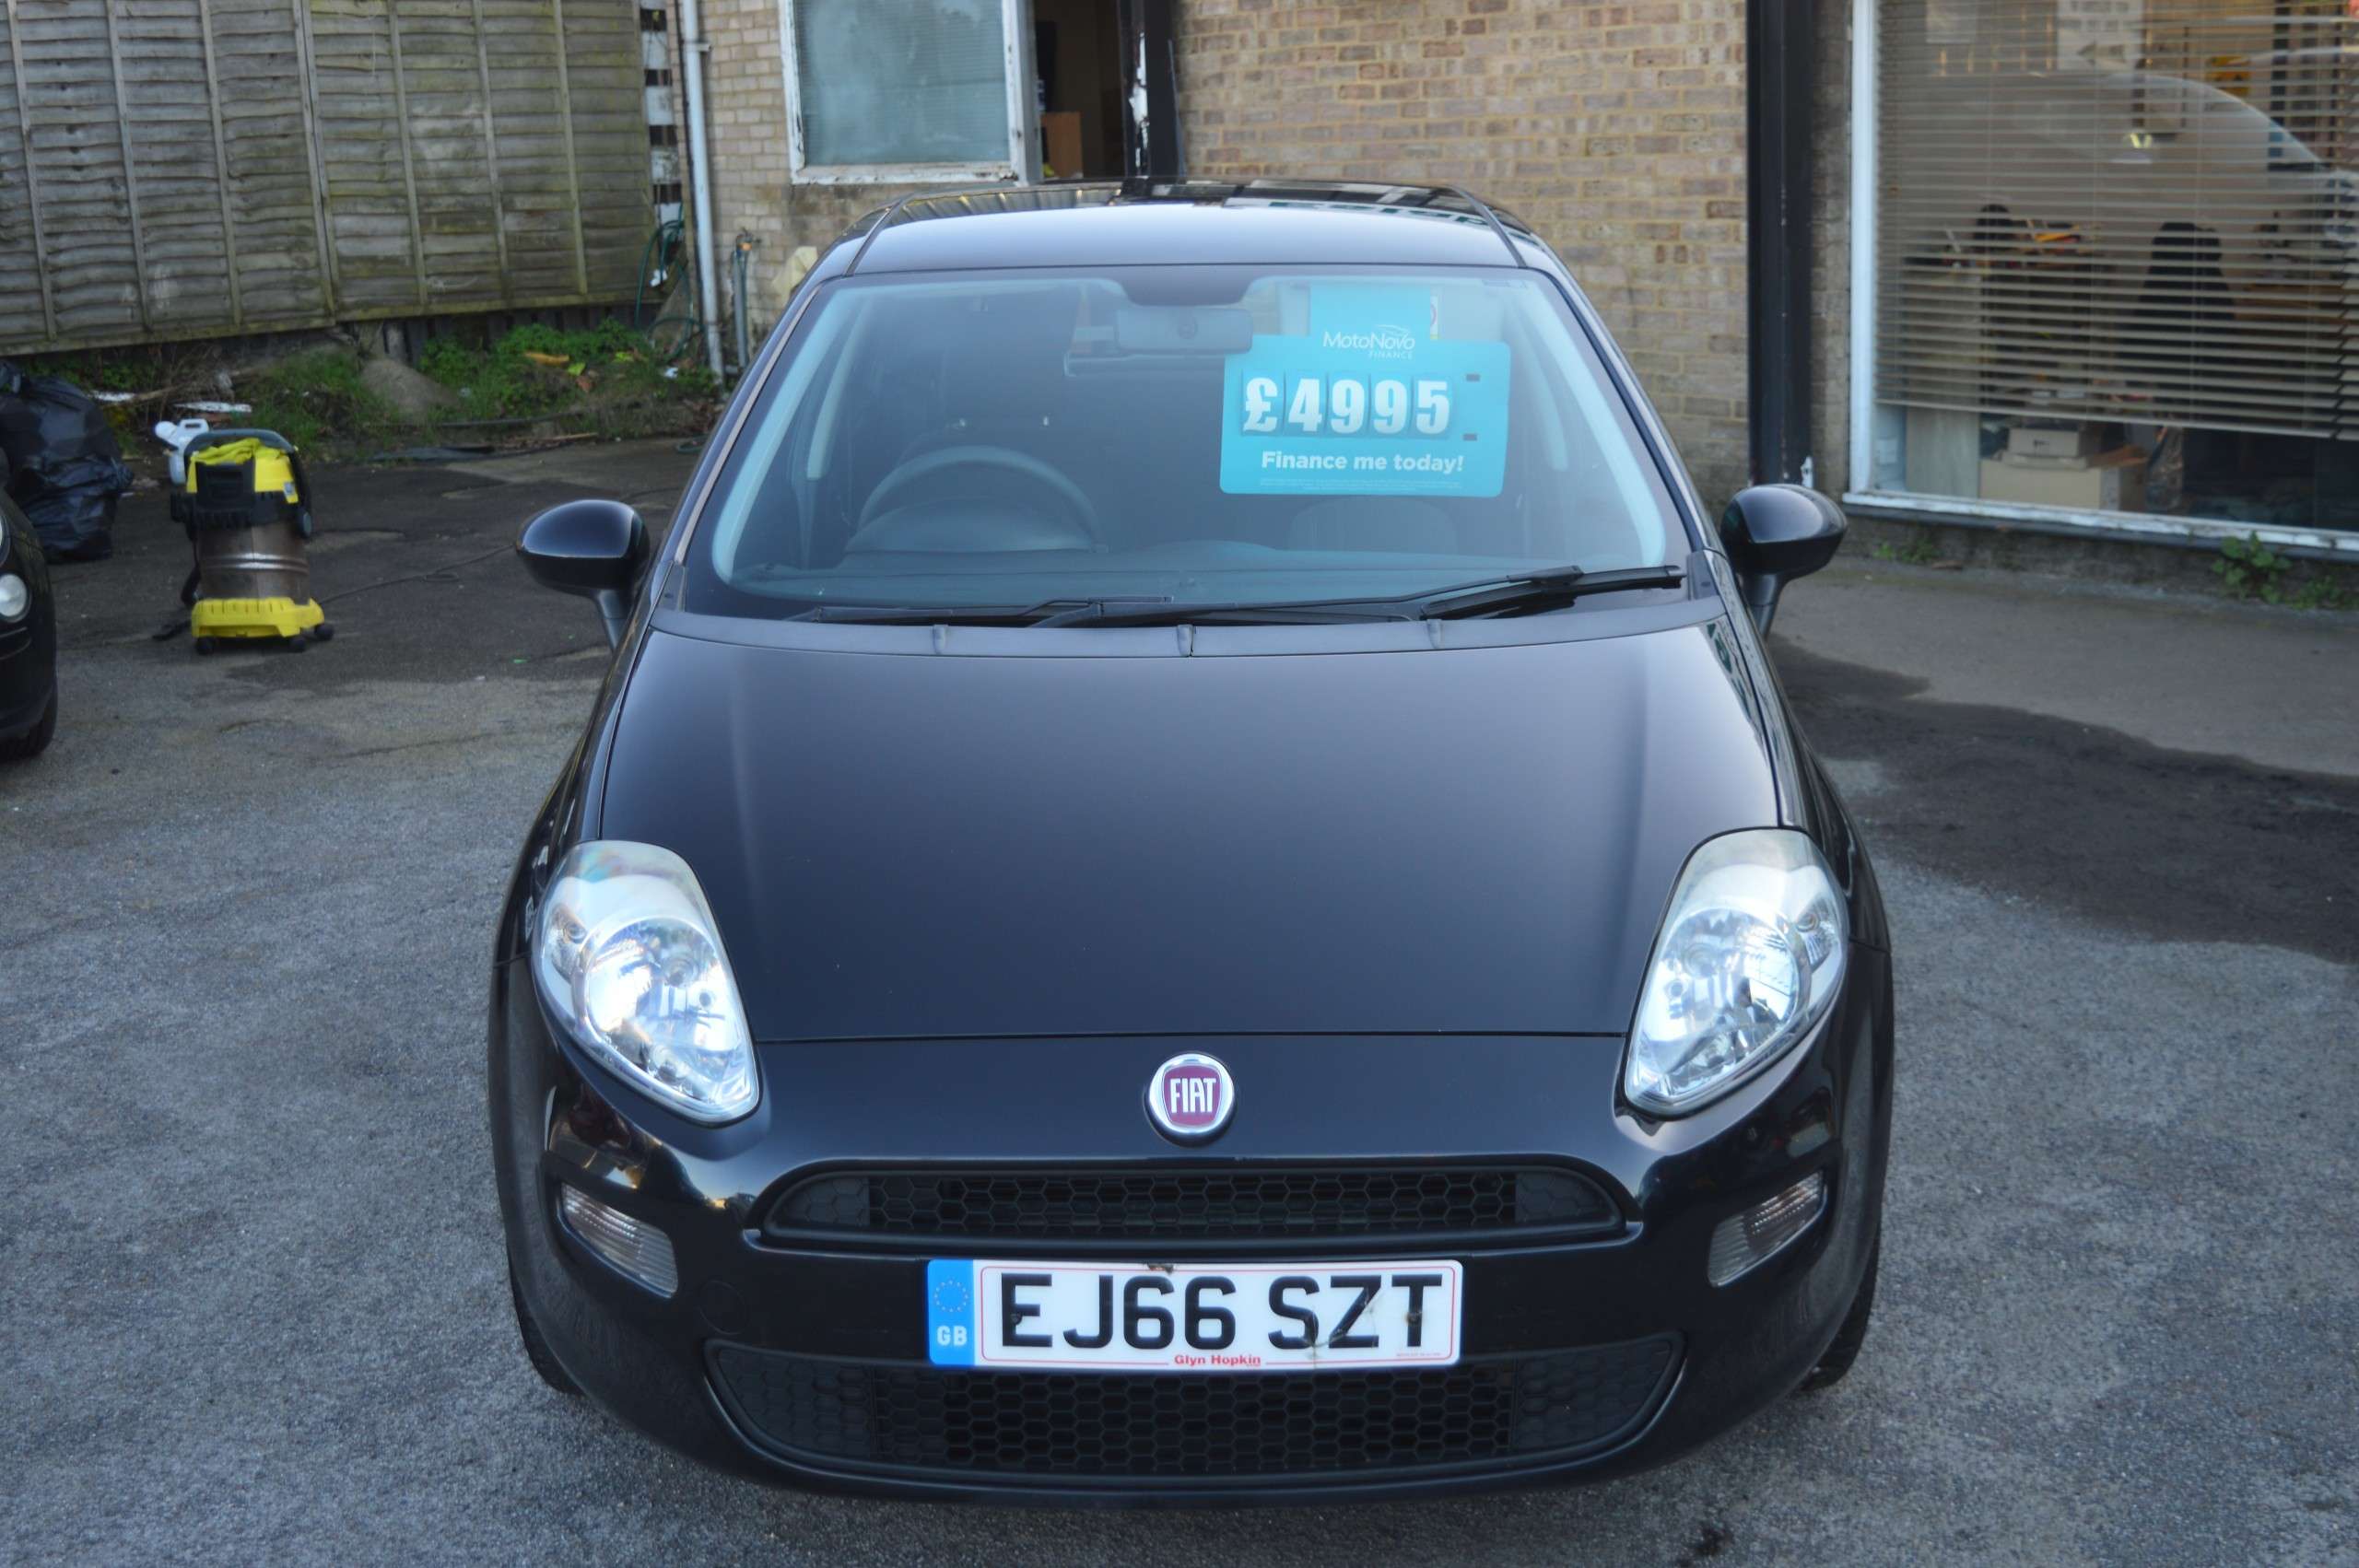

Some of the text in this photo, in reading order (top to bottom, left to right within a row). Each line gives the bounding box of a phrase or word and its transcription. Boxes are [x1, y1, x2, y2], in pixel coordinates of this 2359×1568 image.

[1322, 330, 1416, 350] MotoNovo
[1243, 377, 1450, 435] £4995
[1261, 451, 1465, 475] Finance me today!
[1169, 1078, 1216, 1114] FIAT
[1001, 1272, 1443, 1351] EJ66 SZT
[937, 1325, 968, 1346] GB
[1174, 1354, 1262, 1367] Glyn Hopkin
